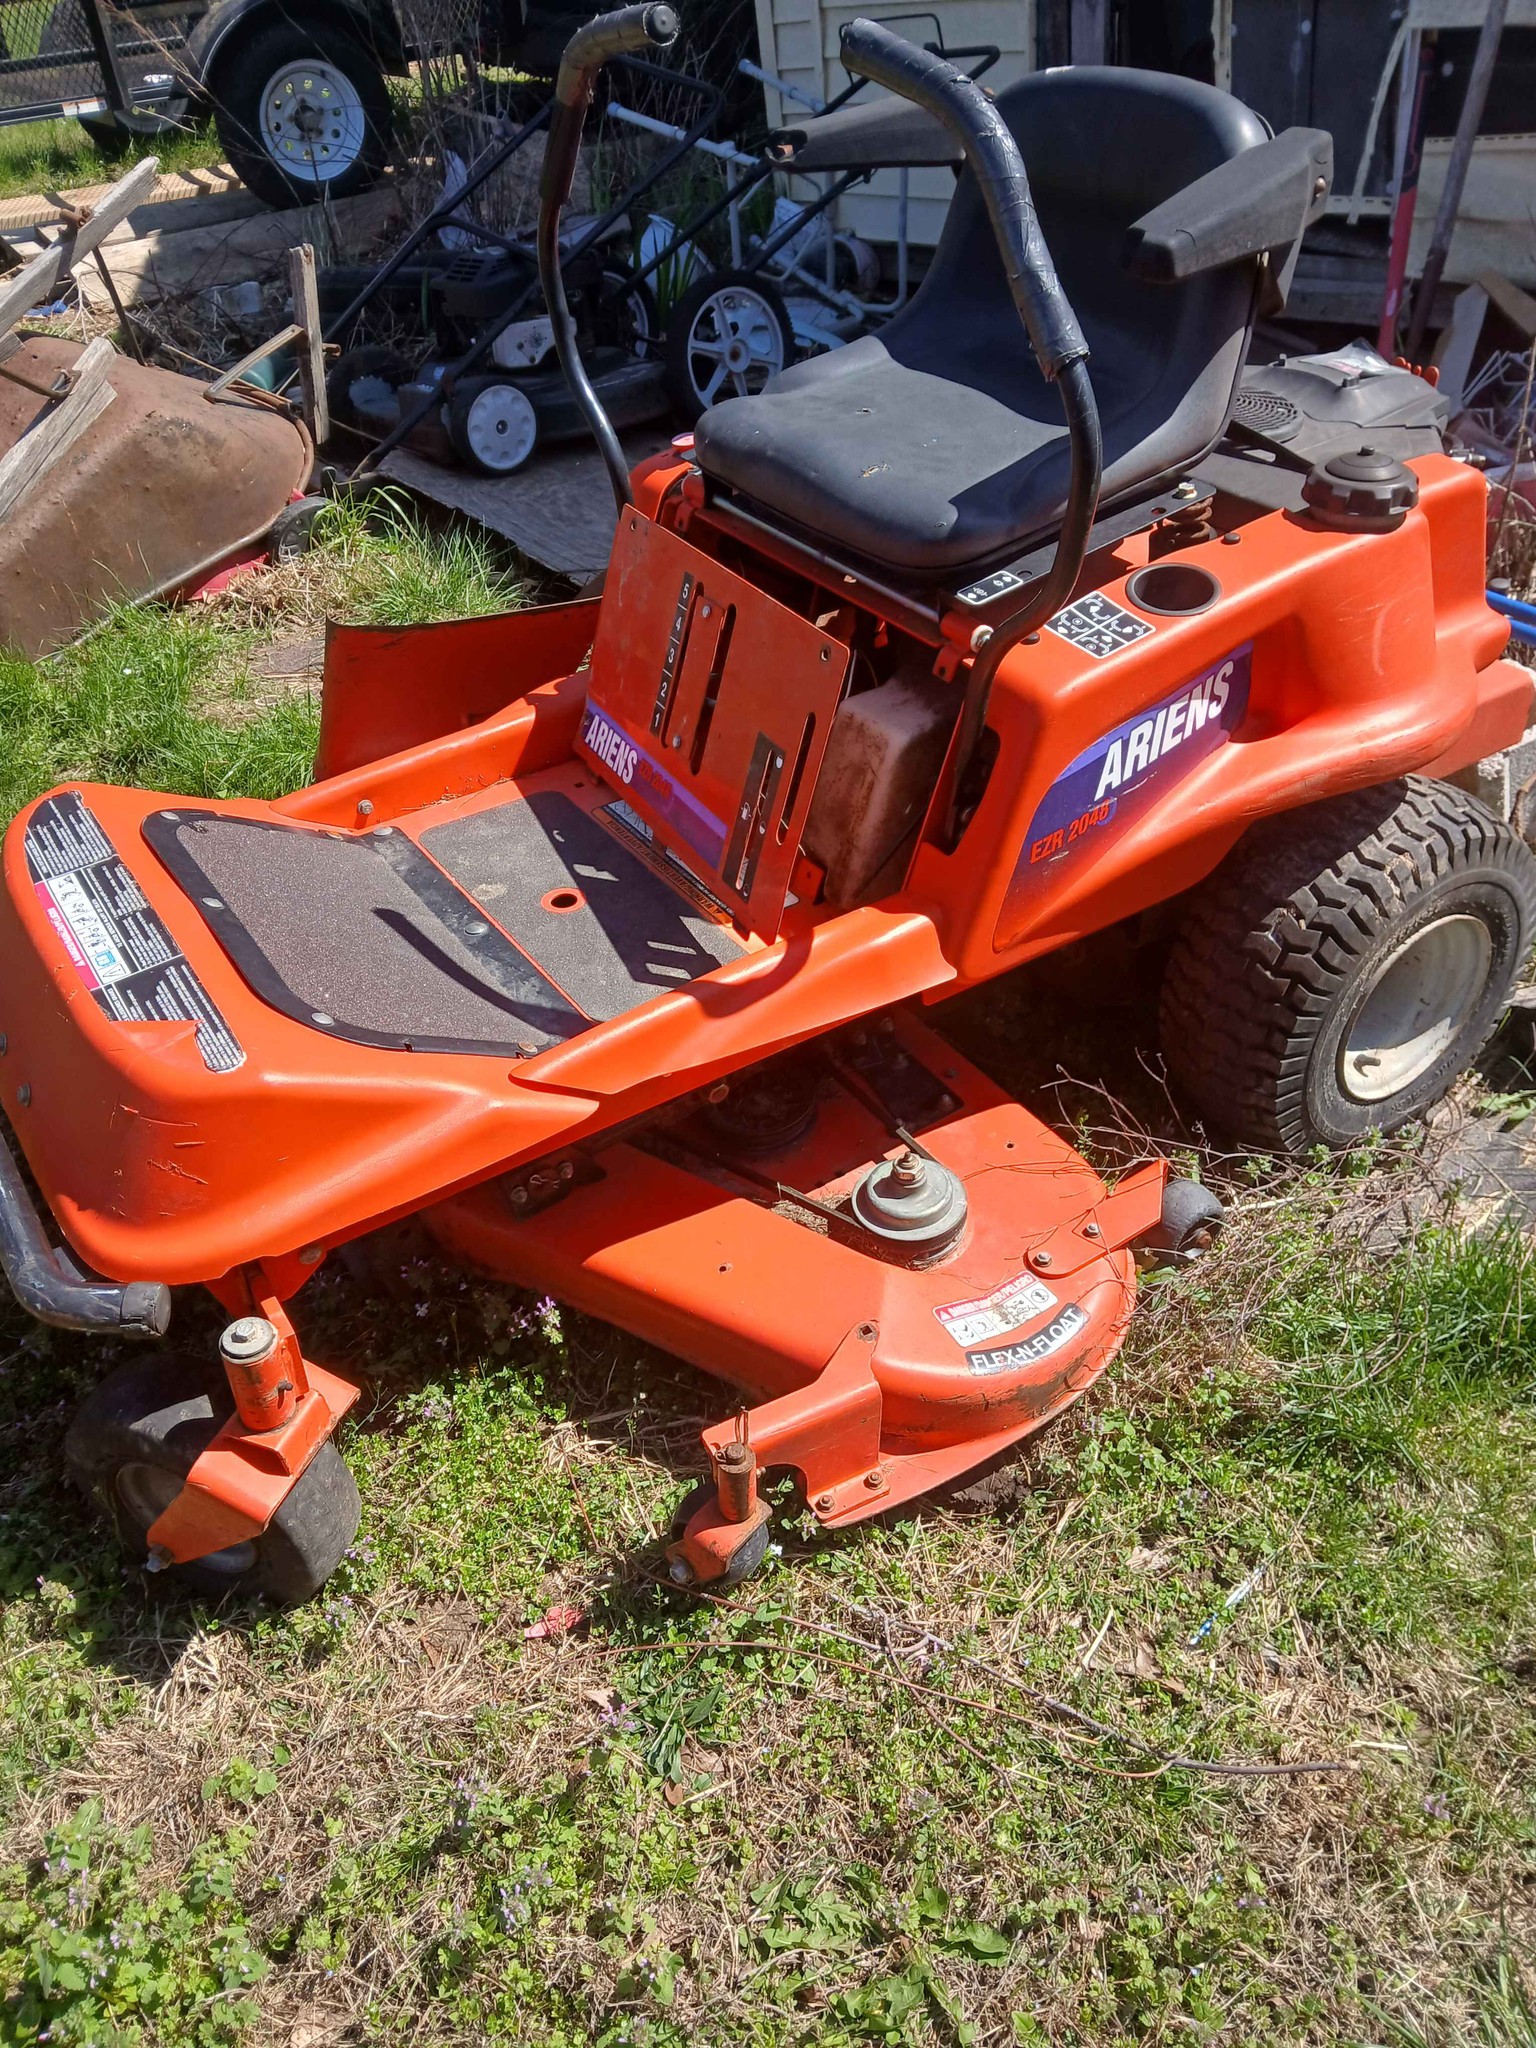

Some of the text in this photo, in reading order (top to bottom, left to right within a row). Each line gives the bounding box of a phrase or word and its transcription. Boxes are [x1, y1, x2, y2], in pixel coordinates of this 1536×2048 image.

[682, 583, 689, 599] 5
[675, 616, 682, 631] 4
[668, 648, 675, 664] 3
[660, 682, 667, 697] 2
[654, 712, 660, 727] 1
[1093, 660, 1234, 802] ARIENS
[584, 713, 638, 785] ARIENS
[1030, 828, 1065, 865] EZR
[970, 1307, 1079, 1371] FLEX-N-FLOAT
